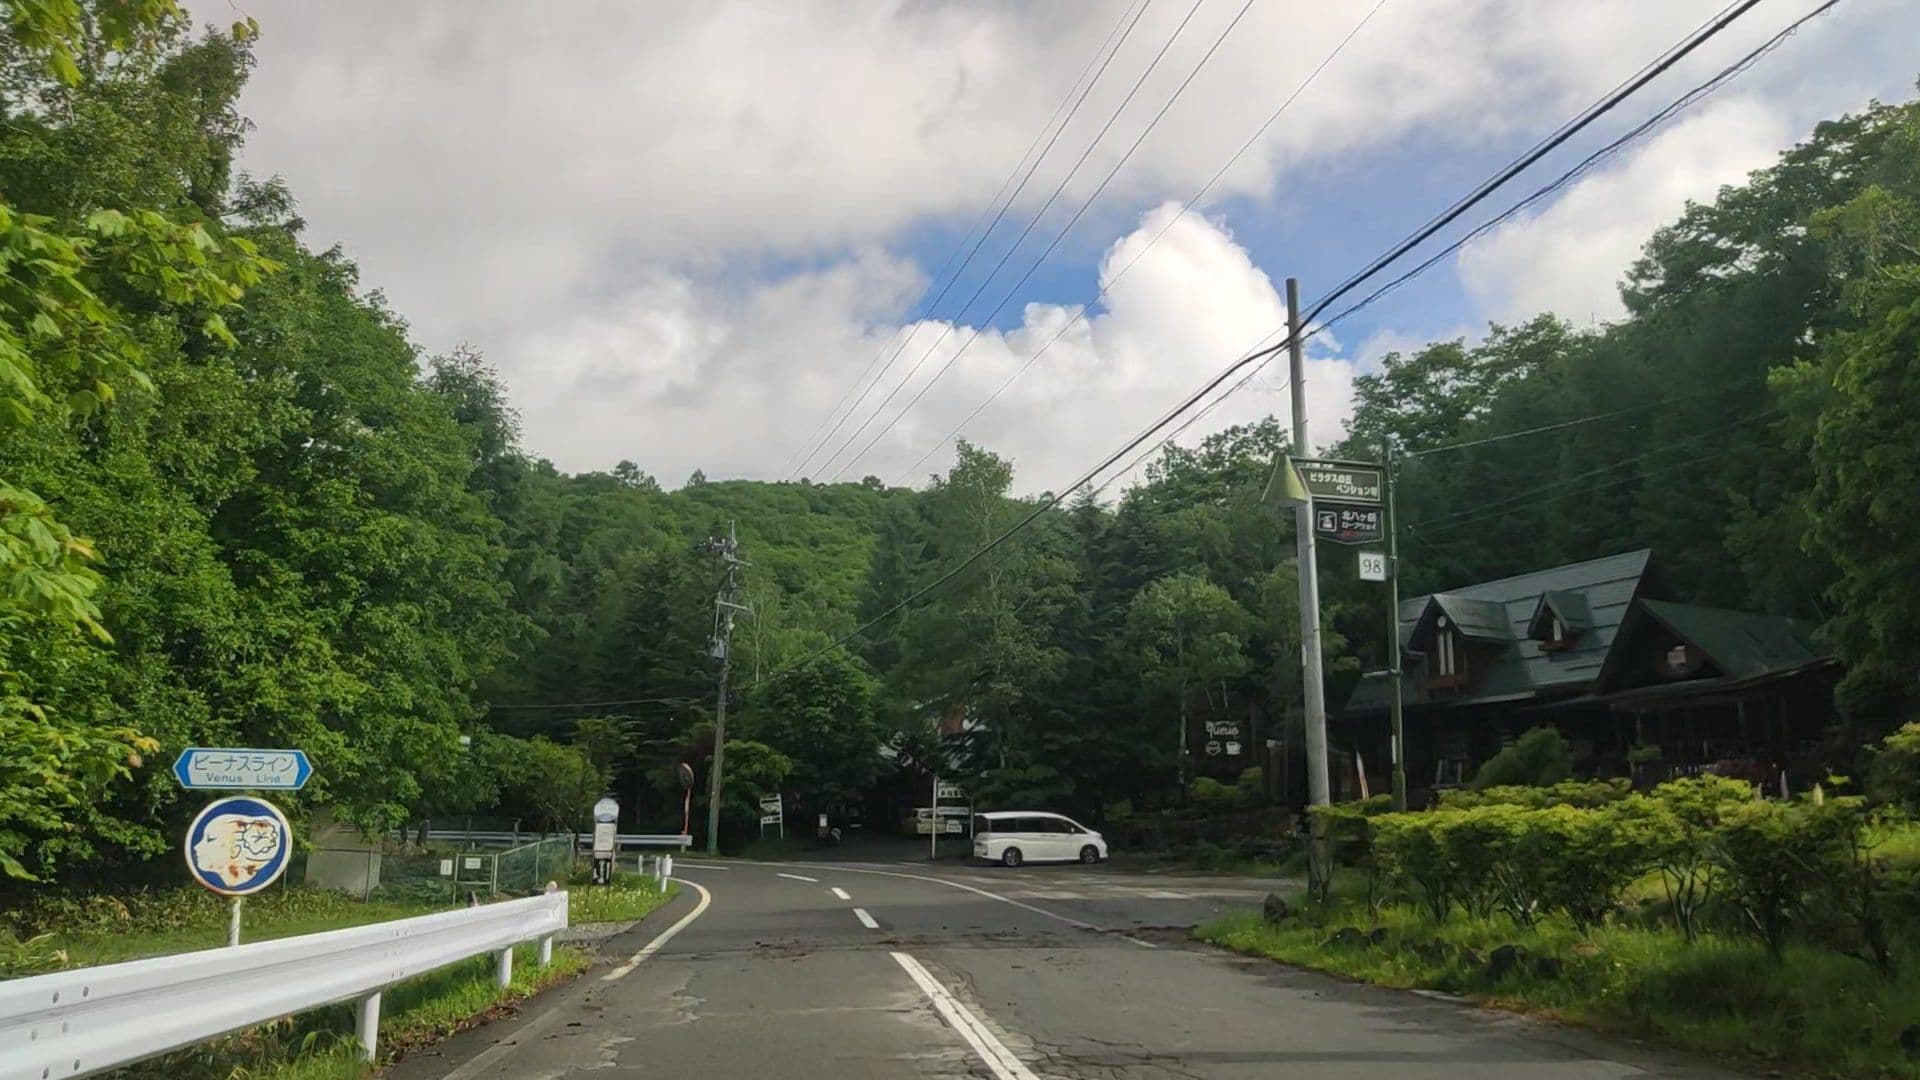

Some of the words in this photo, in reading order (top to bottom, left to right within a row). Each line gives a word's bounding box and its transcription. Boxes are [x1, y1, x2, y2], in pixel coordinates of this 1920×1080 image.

[1363, 559, 1382, 573] 98
[194, 755, 294, 772] ビーナスライン
[206, 772, 242, 783] Venus
[256, 774, 281, 784] Line
